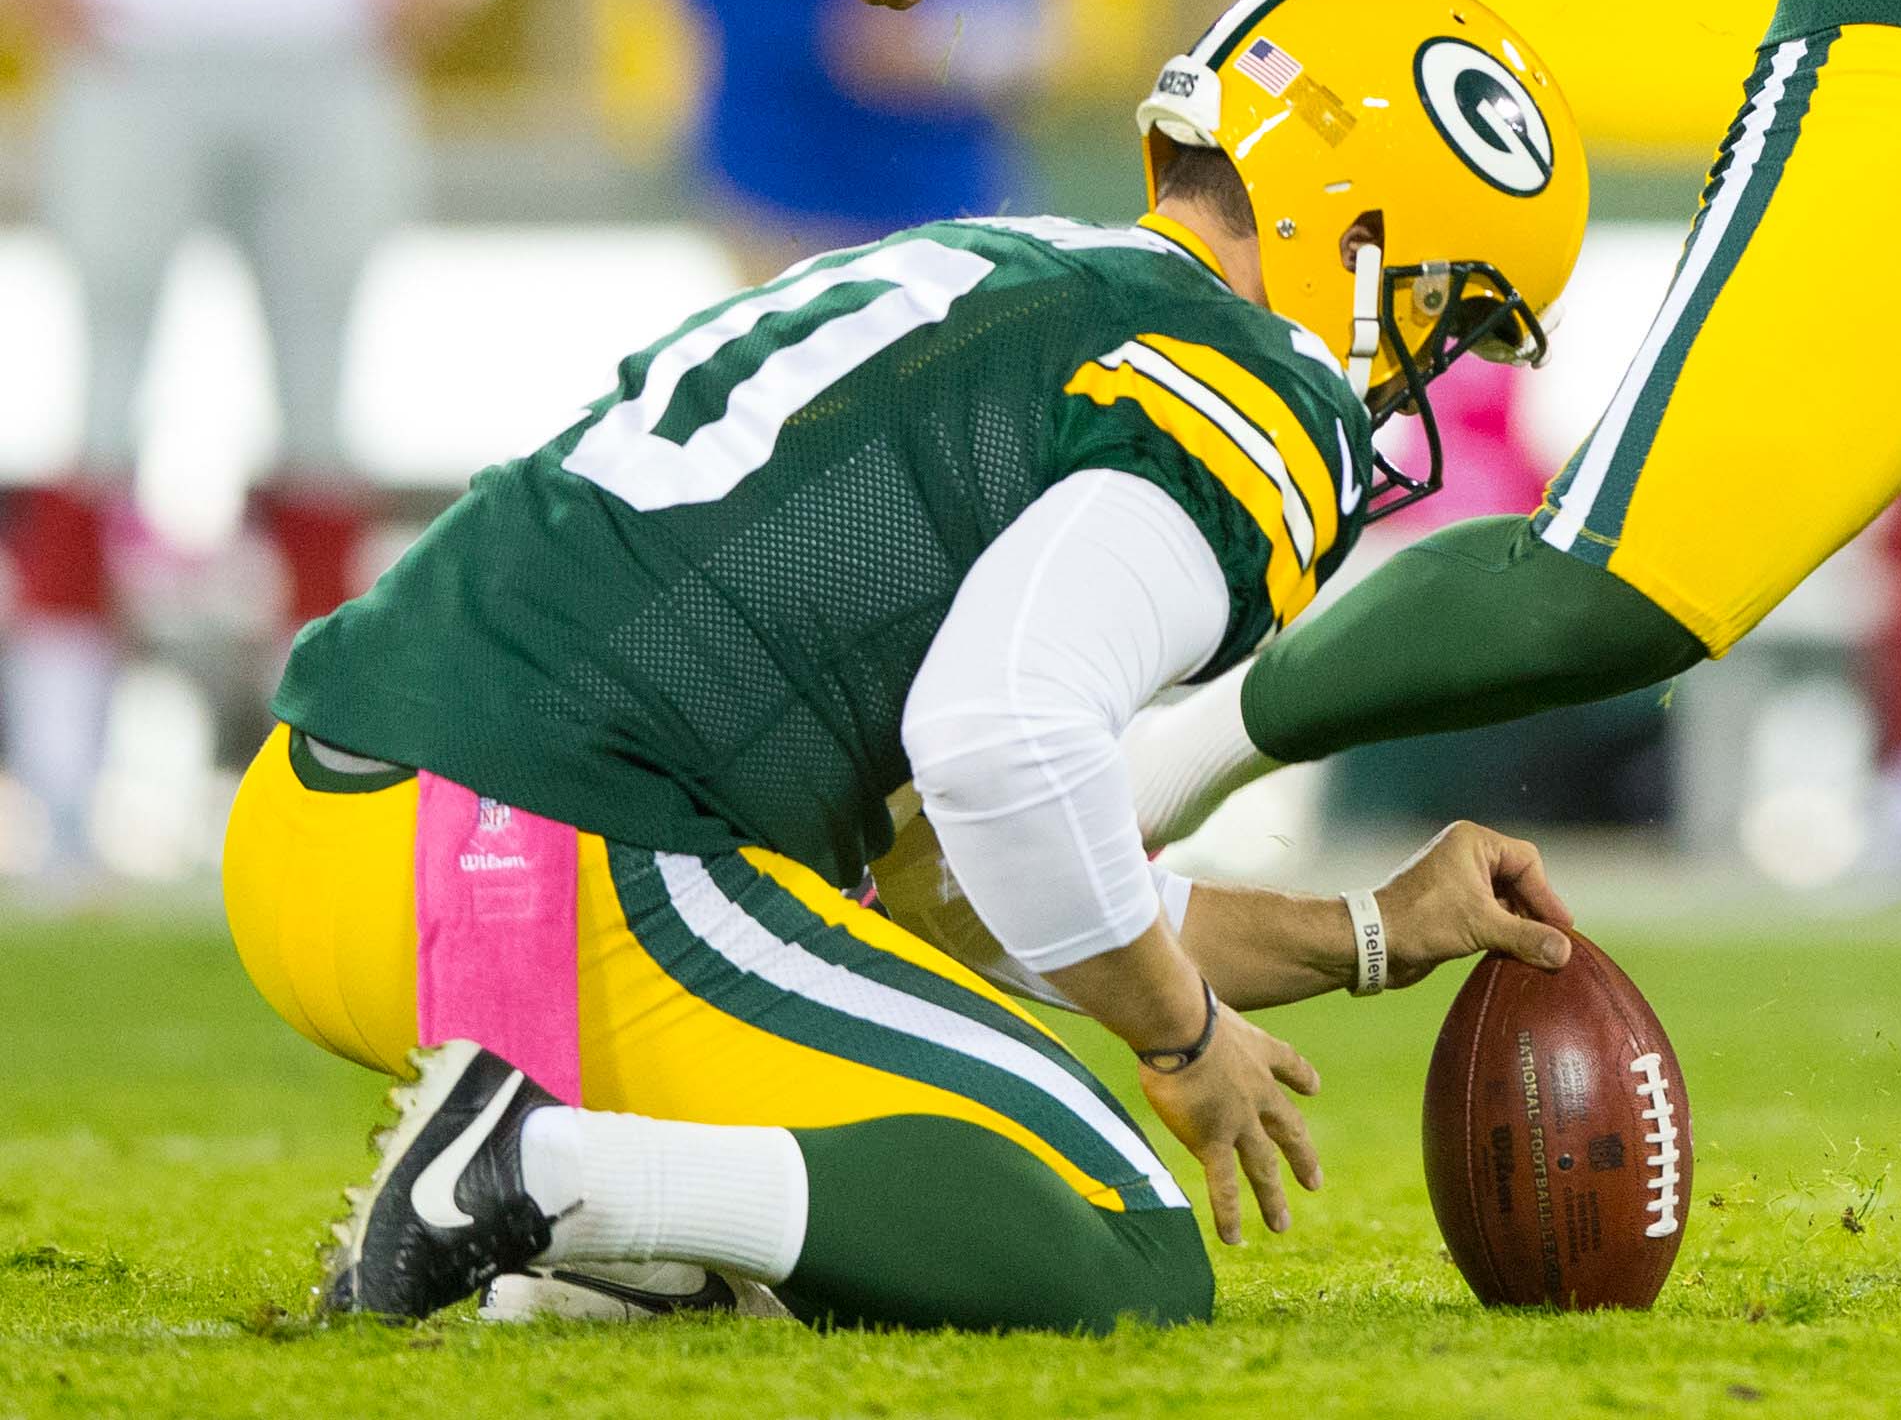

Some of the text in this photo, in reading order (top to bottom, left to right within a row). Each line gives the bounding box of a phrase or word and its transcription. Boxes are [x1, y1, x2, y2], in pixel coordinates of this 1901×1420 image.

[560, 237, 996, 512] 0
[1362, 923, 1384, 990] Believe
[1517, 1030, 1540, 1121] NATIONAL
[1530, 1127, 1553, 1226] FOOTBALL
